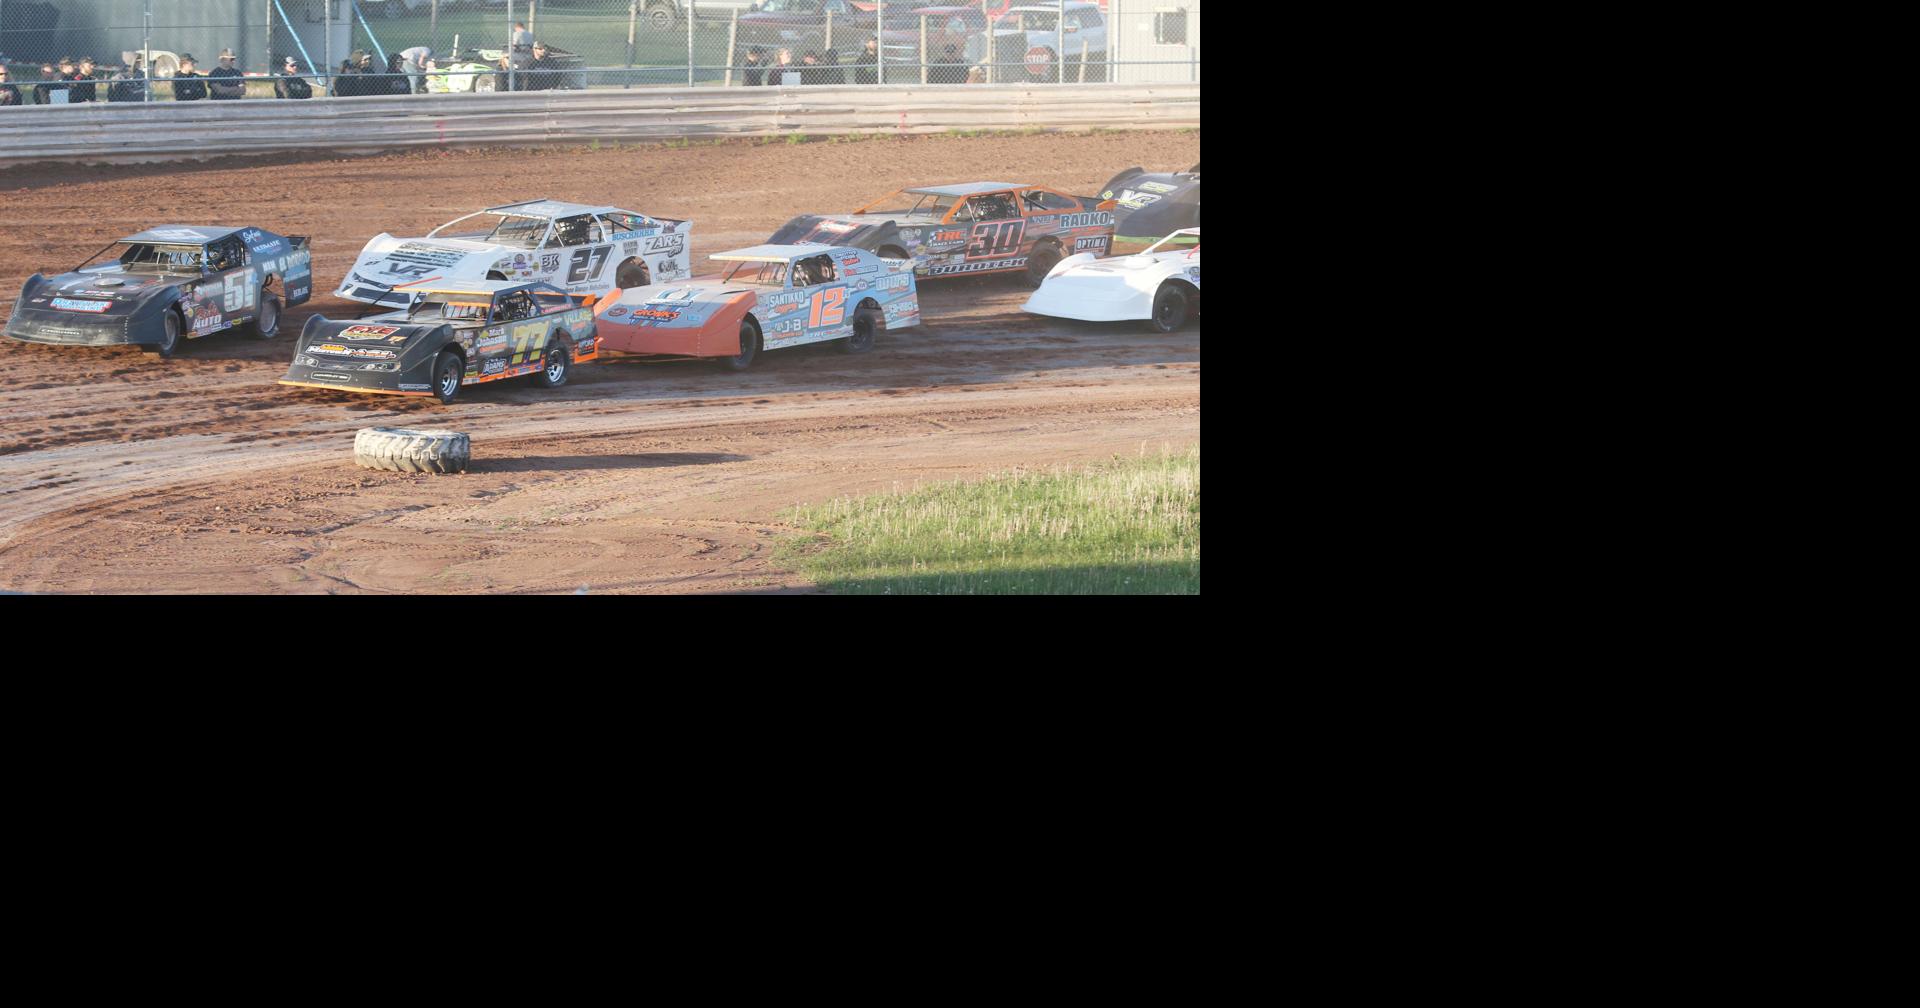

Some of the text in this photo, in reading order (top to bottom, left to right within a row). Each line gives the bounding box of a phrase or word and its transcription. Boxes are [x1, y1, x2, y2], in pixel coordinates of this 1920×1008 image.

[1026, 54, 1049, 64] STOP
[1060, 212, 1110, 229] RADKO
[966, 219, 1025, 261] 30
[1076, 237, 1106, 249] OPTIMA
[566, 244, 616, 286] 27
[770, 291, 804, 307] SANTIKKO
[808, 287, 846, 329] 12
[192, 314, 222, 330] AUTO
[511, 320, 549, 365] 77
